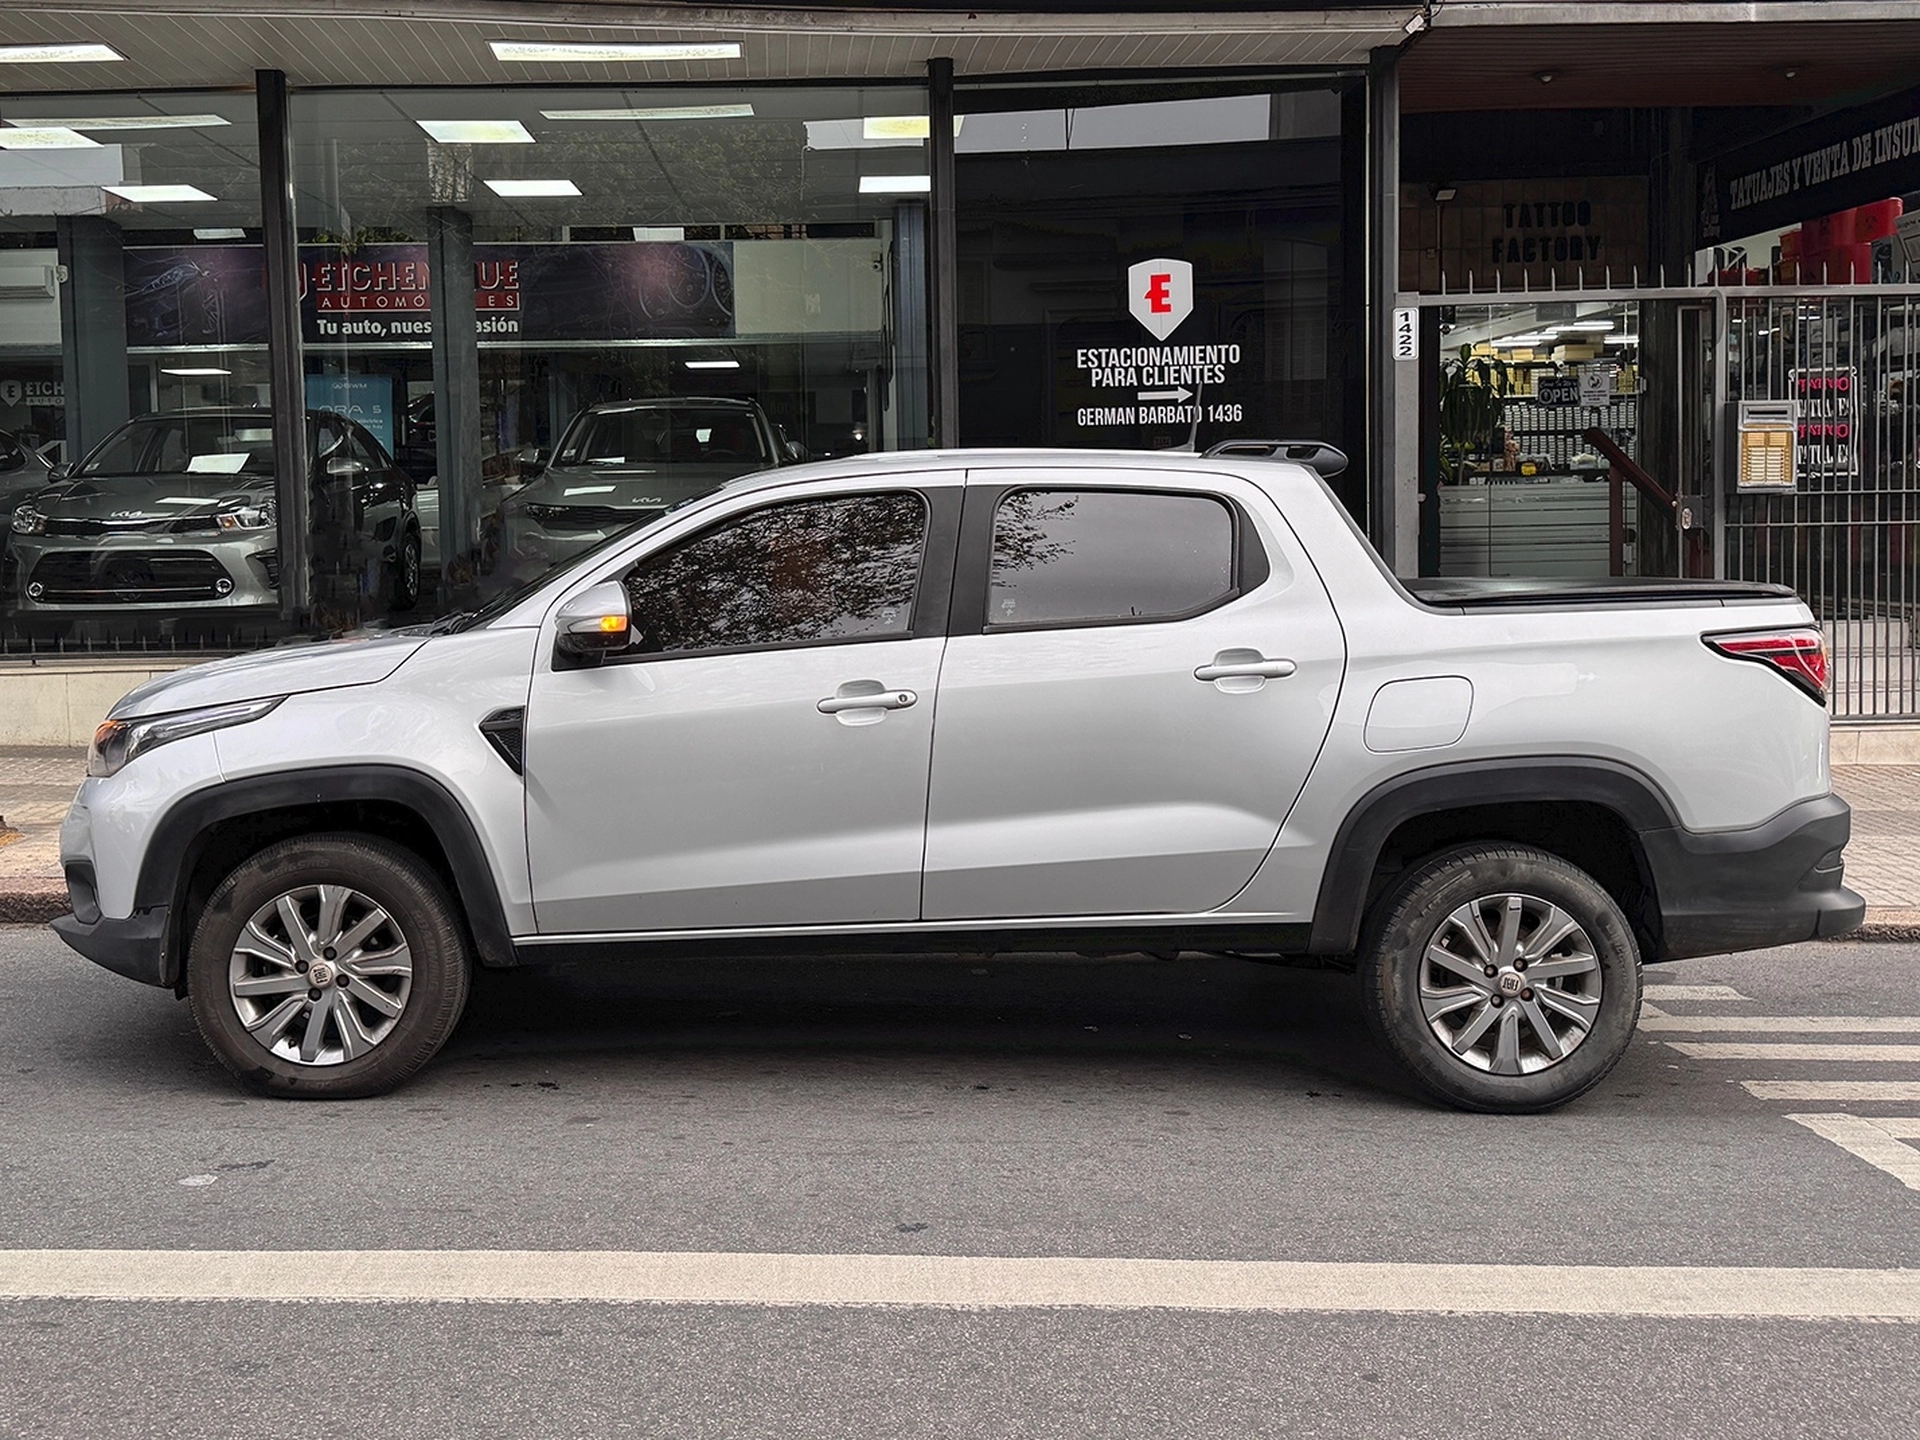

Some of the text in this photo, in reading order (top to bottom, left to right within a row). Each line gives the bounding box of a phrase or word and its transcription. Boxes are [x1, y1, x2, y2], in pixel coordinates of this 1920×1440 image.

[1730, 161, 1790, 210] TATUAJES
[1792, 155, 1801, 190] Y
[1803, 140, 1850, 187] VENTA
[1852, 132, 1871, 171] DE
[1503, 201, 1591, 229] TATTOO
[1492, 235, 1600, 263] FACTORY
[317, 319, 338, 334] Tu
[342, 319, 387, 337] auto,
[391, 321, 432, 334] nues
[1399, 311, 1412, 356] 1422
[1077, 344, 1241, 368] ESTACIONAMIENTO
[1091, 364, 1225, 388] PARA CLIENTES
[25, 381, 64, 396] ETCH
[1540, 387, 1578, 404] OPEN
[1077, 403, 1243, 426] GERMAN BARBATO 1436
